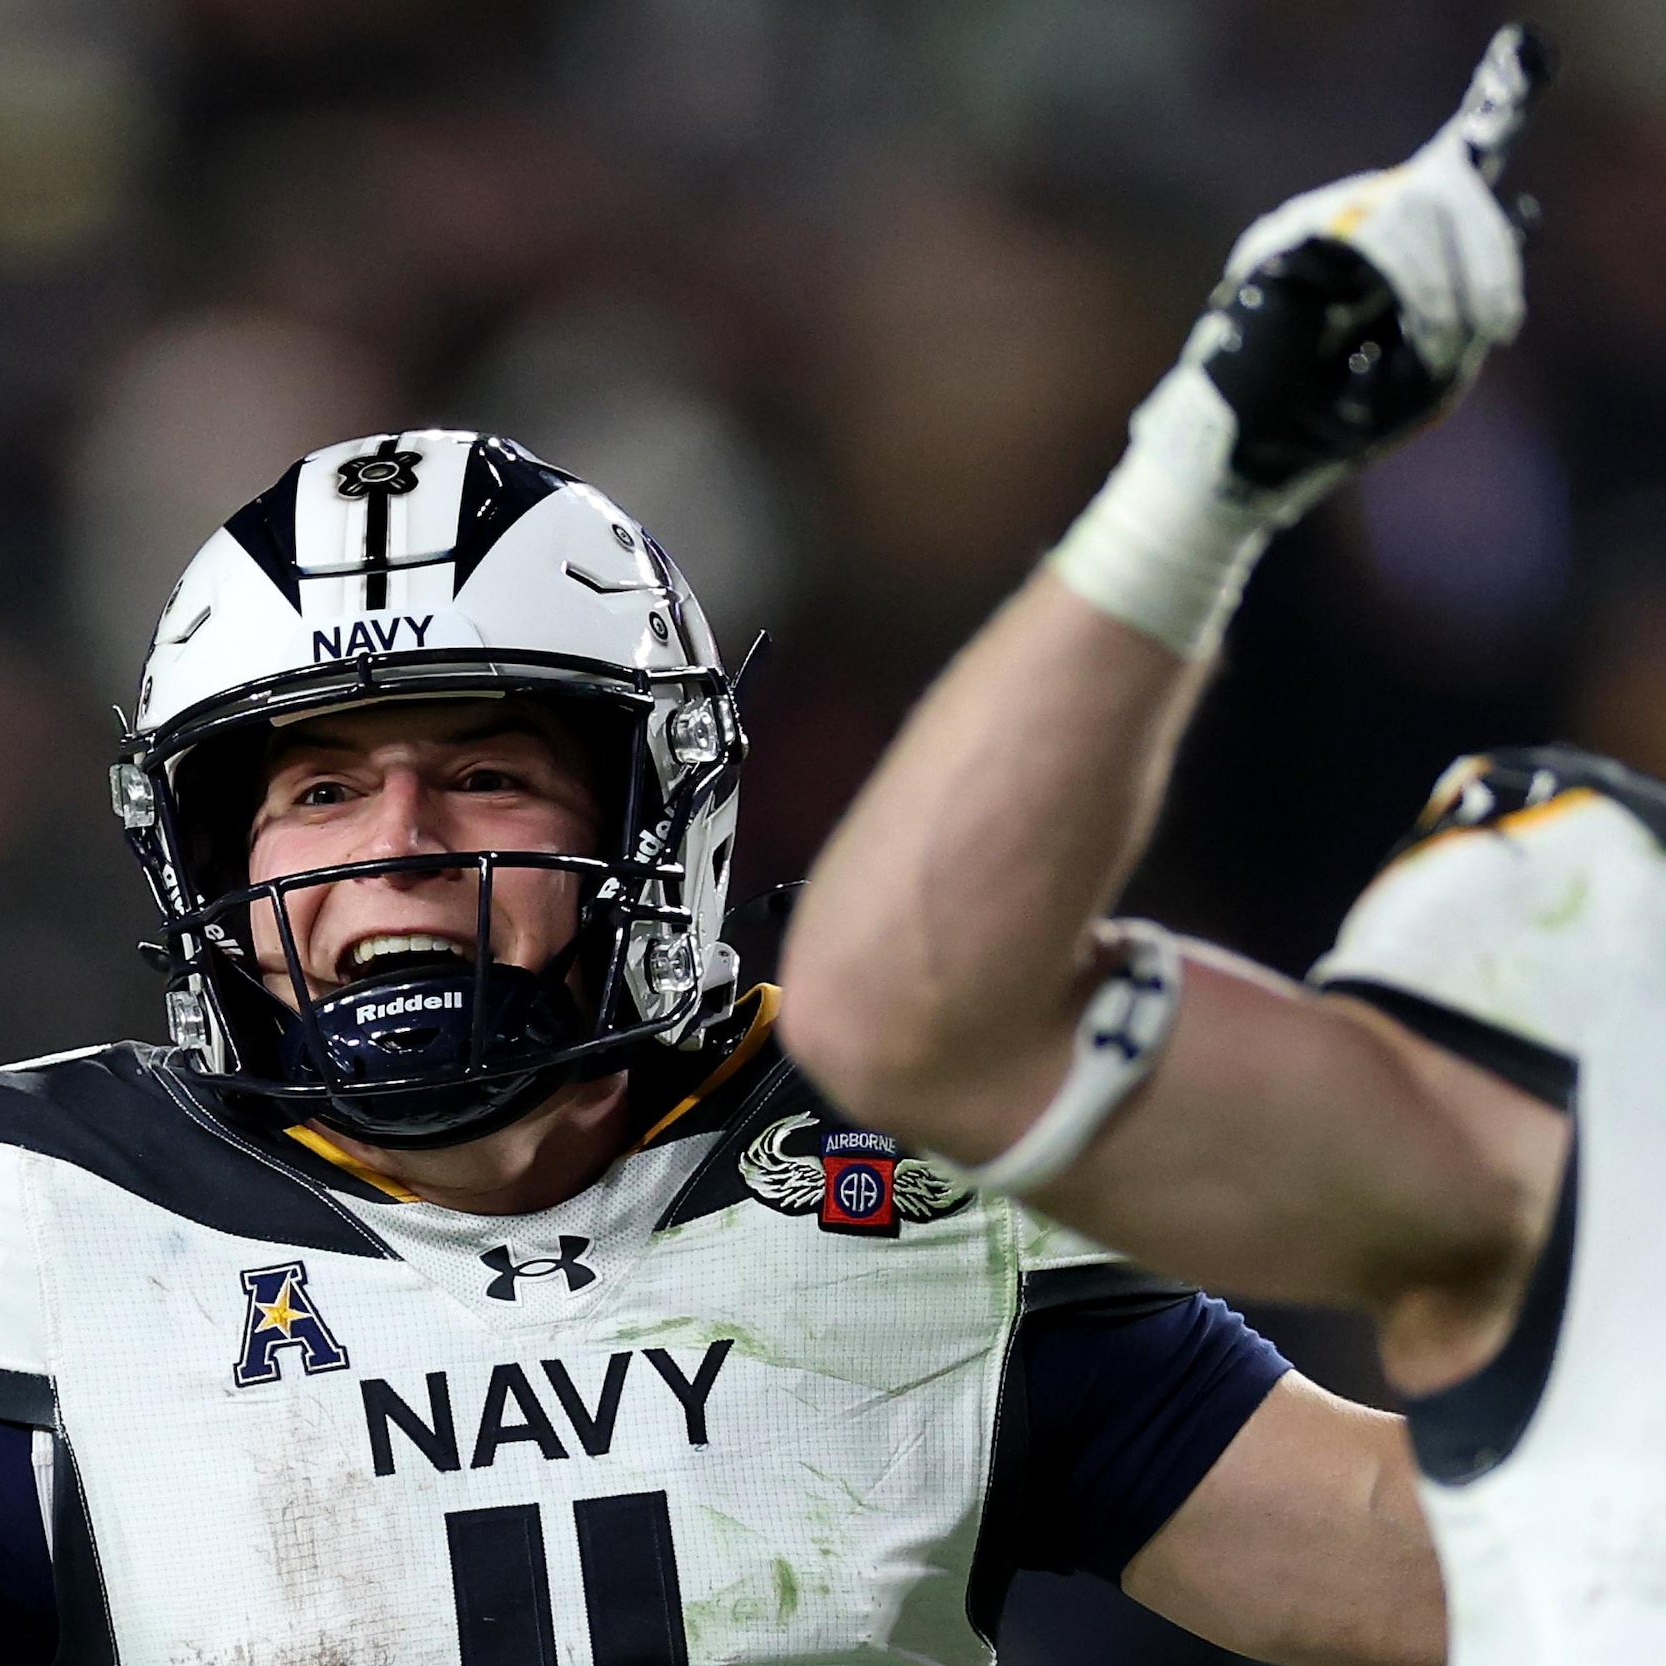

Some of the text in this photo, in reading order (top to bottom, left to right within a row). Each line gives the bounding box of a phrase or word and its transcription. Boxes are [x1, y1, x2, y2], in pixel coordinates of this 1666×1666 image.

[313, 615, 434, 663] NAVY
[356, 992, 462, 1025] Riddell
[826, 1133, 896, 1154] AIRBORNE
[840, 1173, 877, 1212] AA
[234, 1260, 349, 1388] A
[360, 1339, 734, 1476] NAVY
